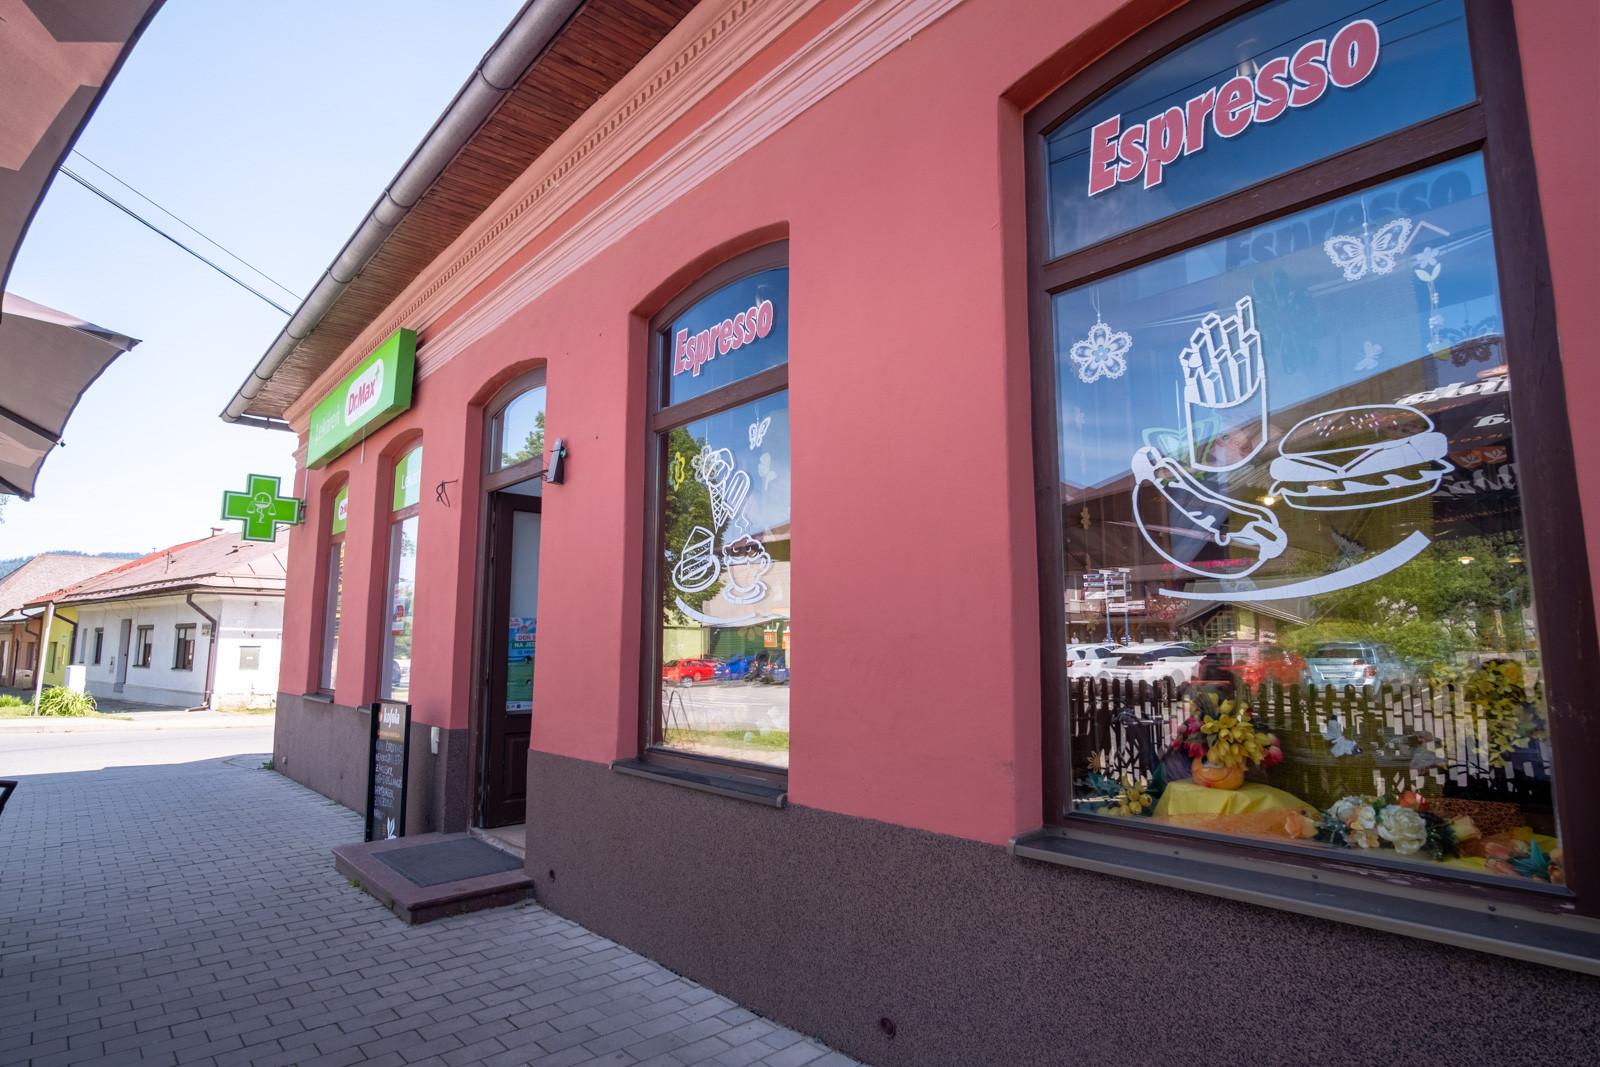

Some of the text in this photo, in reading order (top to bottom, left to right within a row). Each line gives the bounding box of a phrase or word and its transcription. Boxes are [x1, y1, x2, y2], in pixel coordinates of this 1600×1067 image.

[1087, 18, 1381, 197] Espresso
[673, 299, 774, 378] Espresso
[347, 378, 376, 417] Dr.Max
